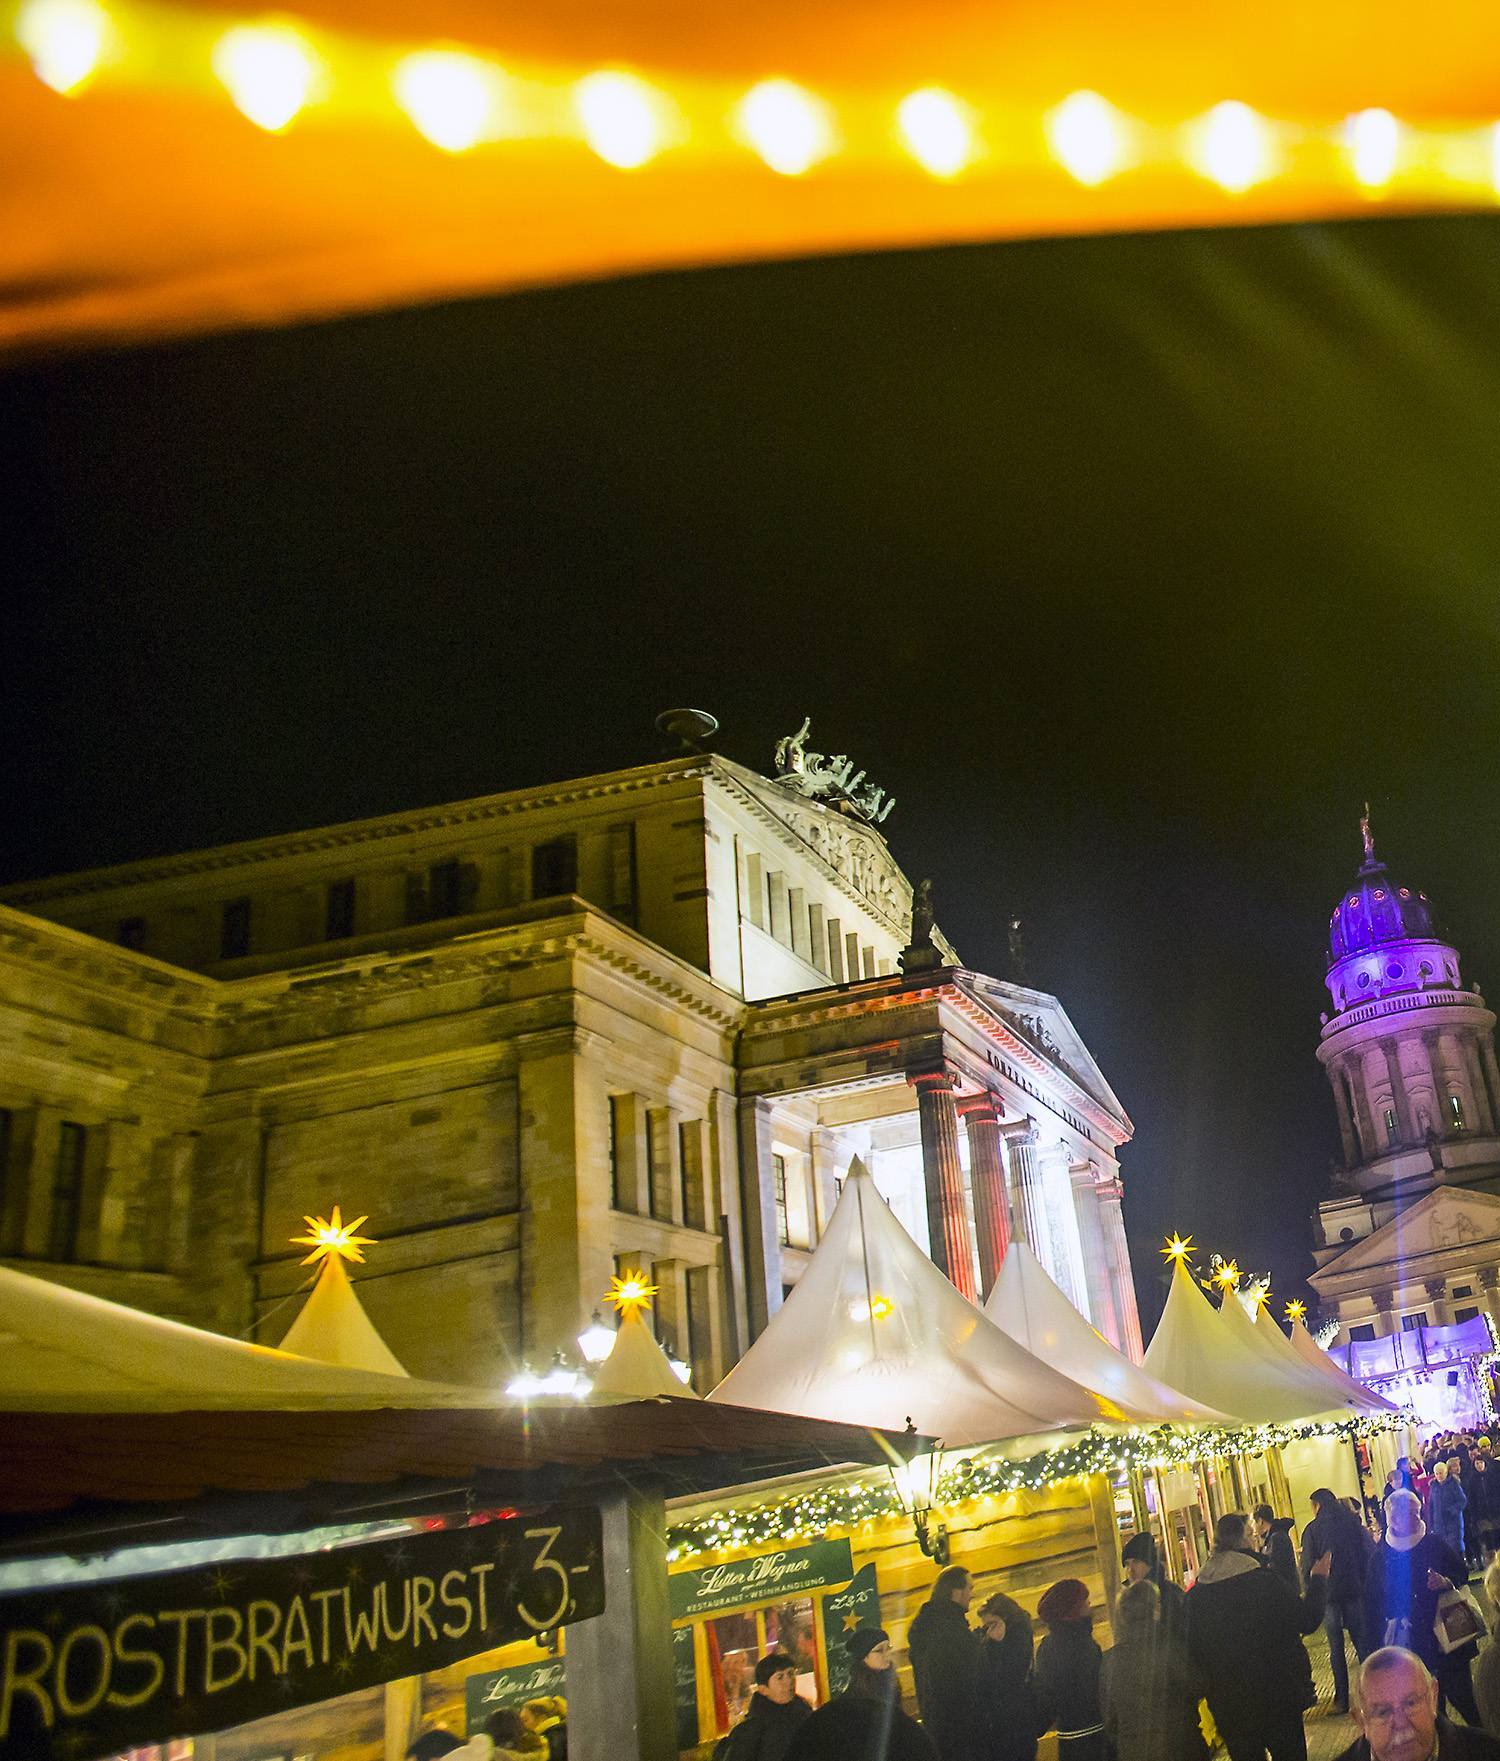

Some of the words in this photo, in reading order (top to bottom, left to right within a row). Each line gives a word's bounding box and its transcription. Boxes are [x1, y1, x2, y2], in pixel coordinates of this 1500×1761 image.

[697, 1565, 746, 1596] Lutter
[752, 1552, 810, 1582] Wegner
[0, 1564, 495, 1736] ROSTBRATWURST
